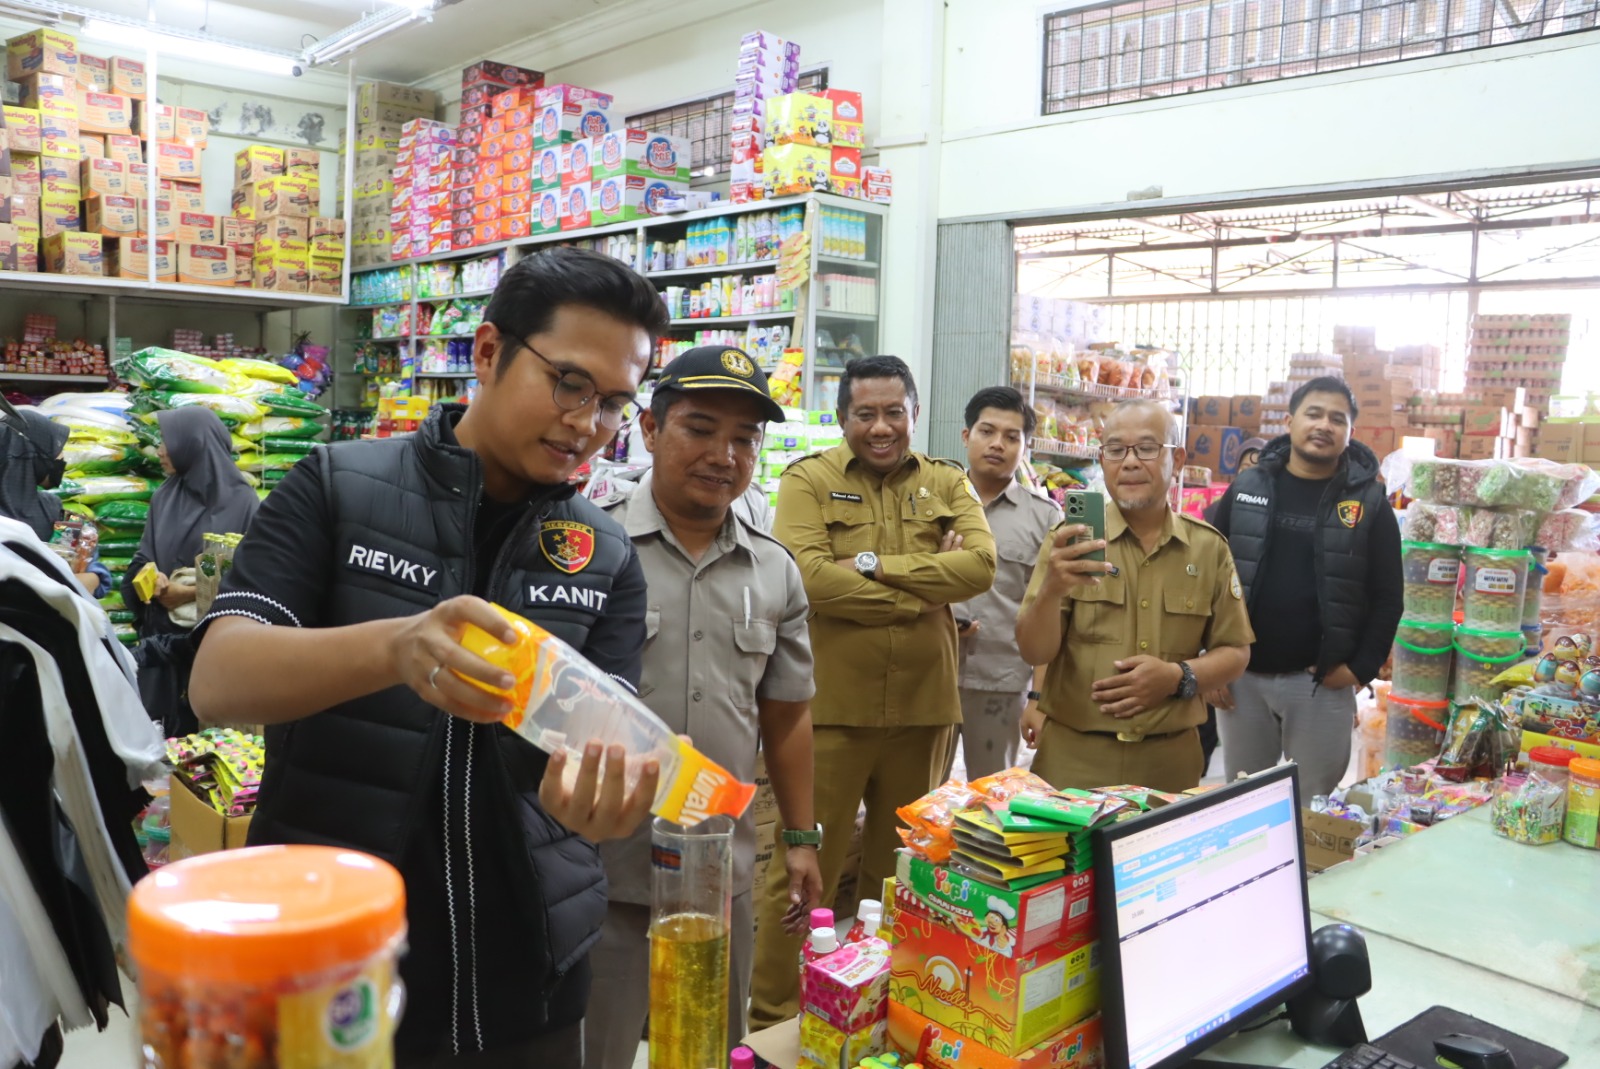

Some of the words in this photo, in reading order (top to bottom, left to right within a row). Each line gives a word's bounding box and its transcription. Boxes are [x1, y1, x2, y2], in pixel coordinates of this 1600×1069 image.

[587, 115, 602, 125] POP
[590, 124, 605, 133] MIE
[653, 143, 668, 152] POP
[655, 152, 670, 160] MIE
[1236, 492, 1268, 506] FIRMAN
[348, 544, 438, 586] RIEVKY
[529, 585, 607, 611] KANIT
[933, 867, 969, 902] Yupi
[924, 975, 974, 1013] Noodles
[925, 1023, 963, 1061] Yupi
[1050, 1033, 1083, 1063] Yupi
